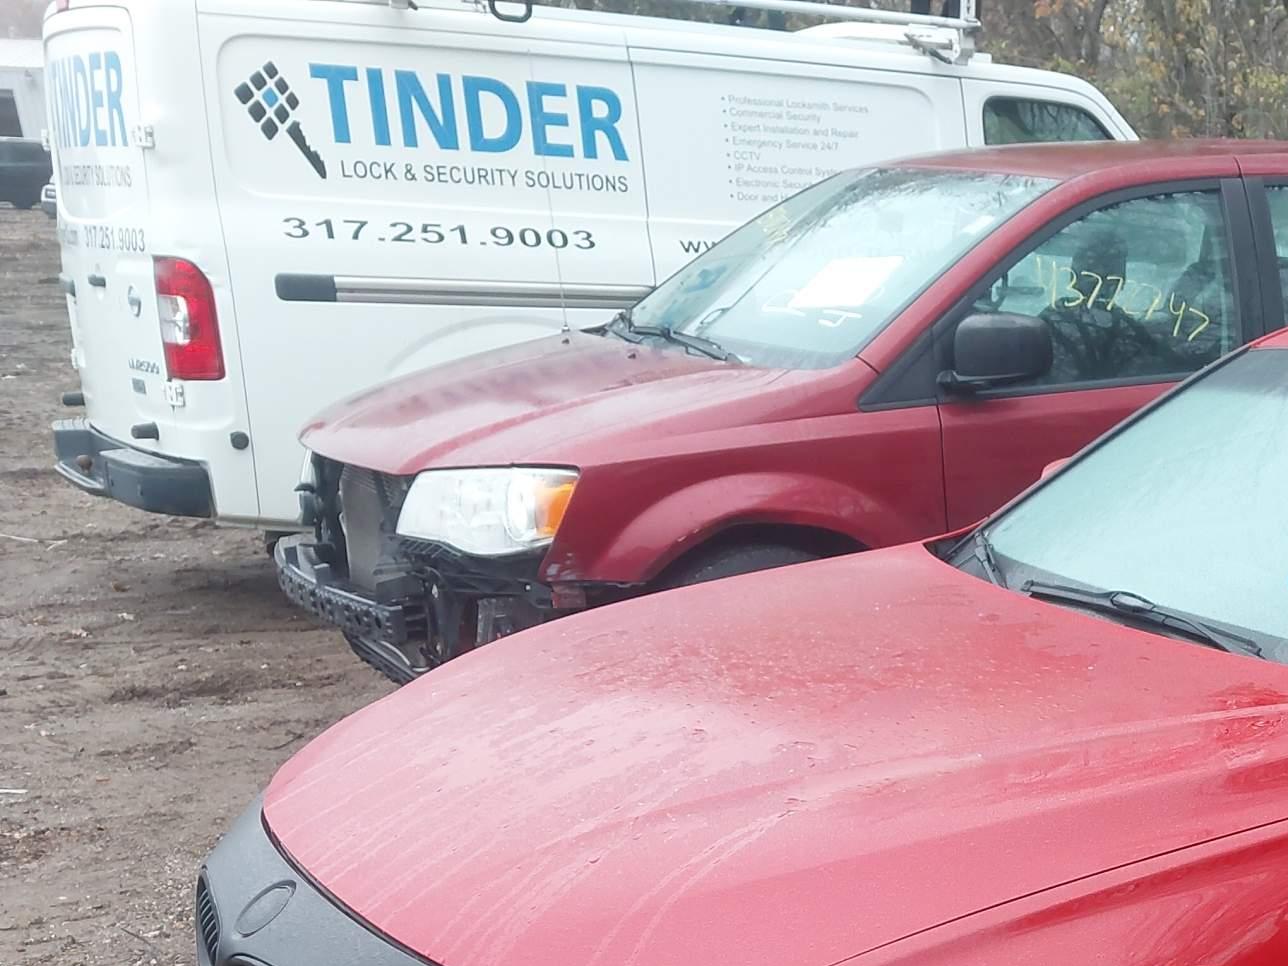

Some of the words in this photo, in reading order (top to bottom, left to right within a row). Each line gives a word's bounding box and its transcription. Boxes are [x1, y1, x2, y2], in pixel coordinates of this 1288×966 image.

[309, 63, 629, 161] TINDER
[734, 151, 760, 160] CCTV
[341, 160, 396, 181] LOCK
[404, 162, 417, 182] &
[424, 164, 517, 187] SECURITY
[525, 170, 629, 192] SOLUTIONS
[282, 216, 596, 250] 317.251.9003
